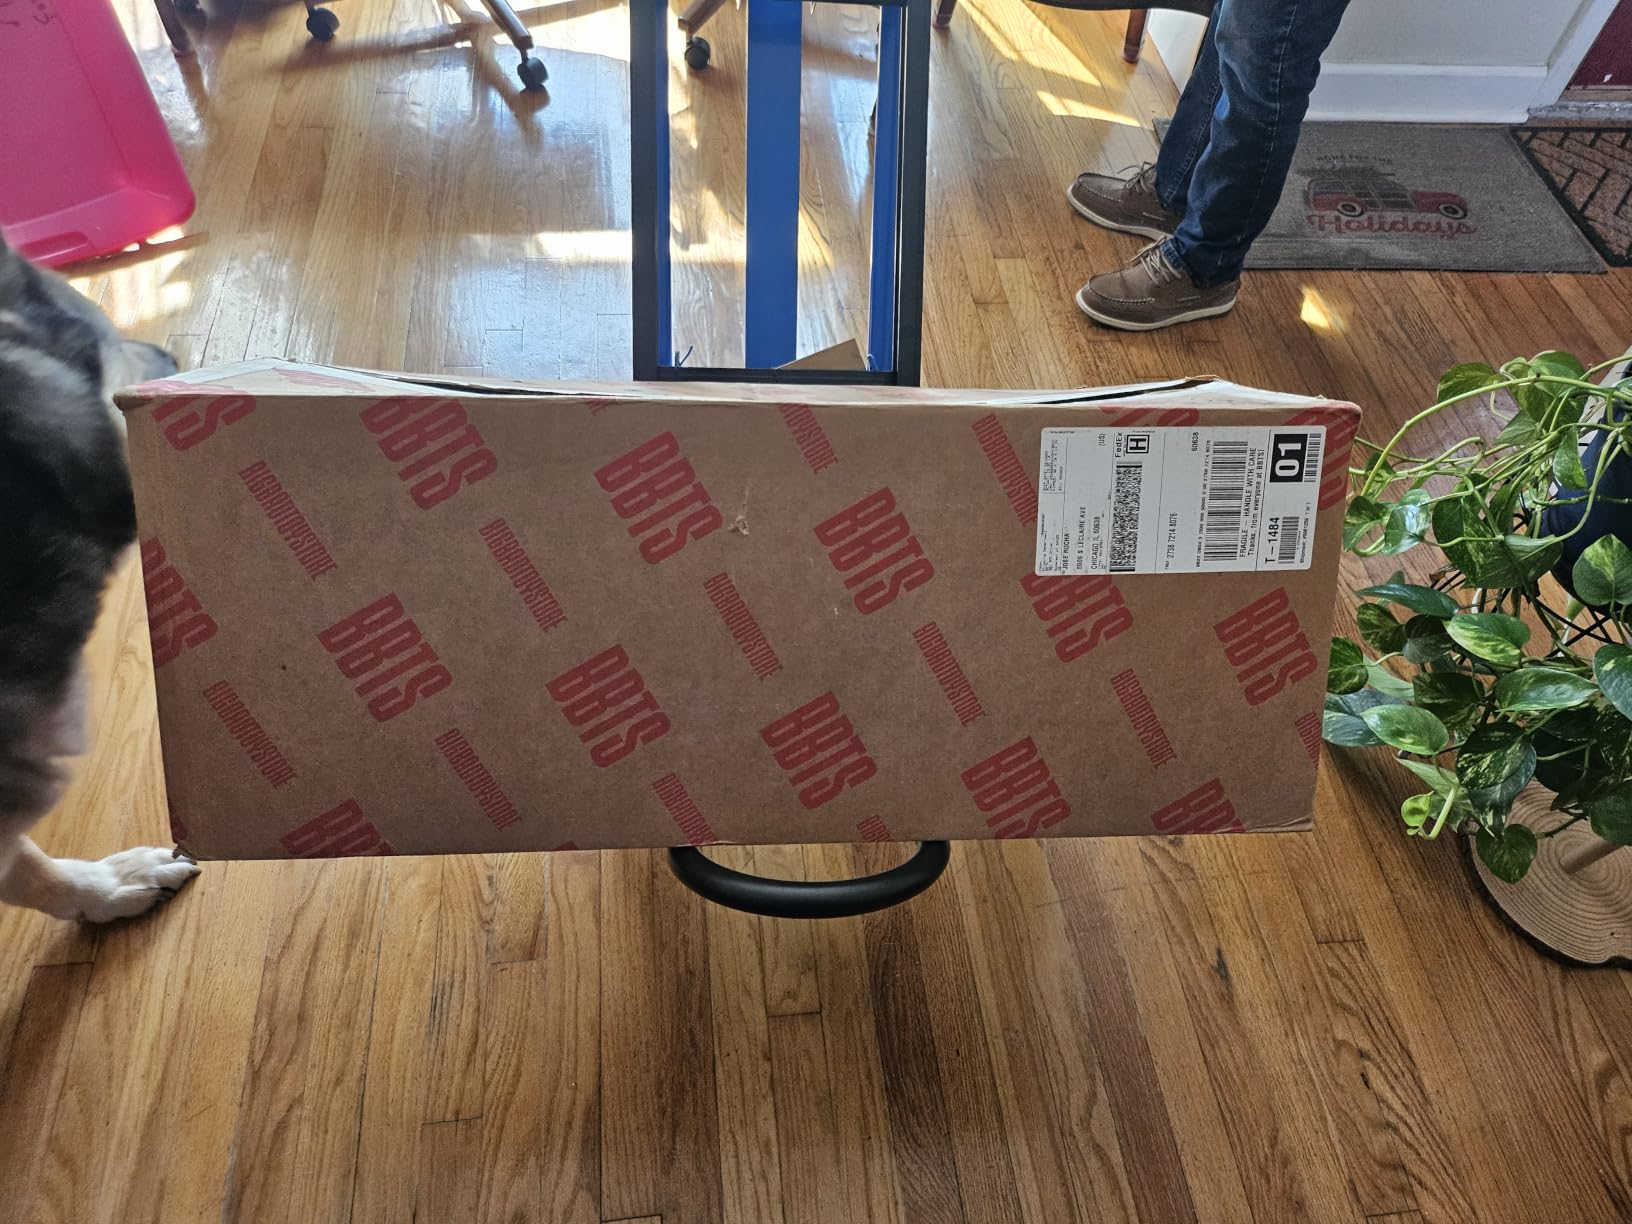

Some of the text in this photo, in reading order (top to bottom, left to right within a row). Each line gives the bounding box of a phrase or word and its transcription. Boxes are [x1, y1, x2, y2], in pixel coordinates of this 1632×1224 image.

[1306, 214, 1477, 239] Holidays
[1098, 434, 1106, 446] (US)
[1114, 432, 1123, 458] FedEx
[1129, 438, 1146, 450] H
[1248, 448, 1256, 466] CARE
[1275, 443, 1302, 476] 01
[1246, 469, 1254, 487] WITH
[593, 431, 723, 565] BBTS
[1243, 489, 1252, 517] HANDLE
[1250, 513, 1258, 528] from
[1168, 528, 1176, 542] 7214
[1240, 528, 1248, 557] FRAGILE
[814, 486, 934, 615] BBTS
[318, 591, 453, 722] BBTS
[1214, 586, 1318, 706] BBTS
[545, 644, 671, 768] BBTS
[760, 691, 877, 810] BBTS
[960, 736, 1071, 839] BBTS
